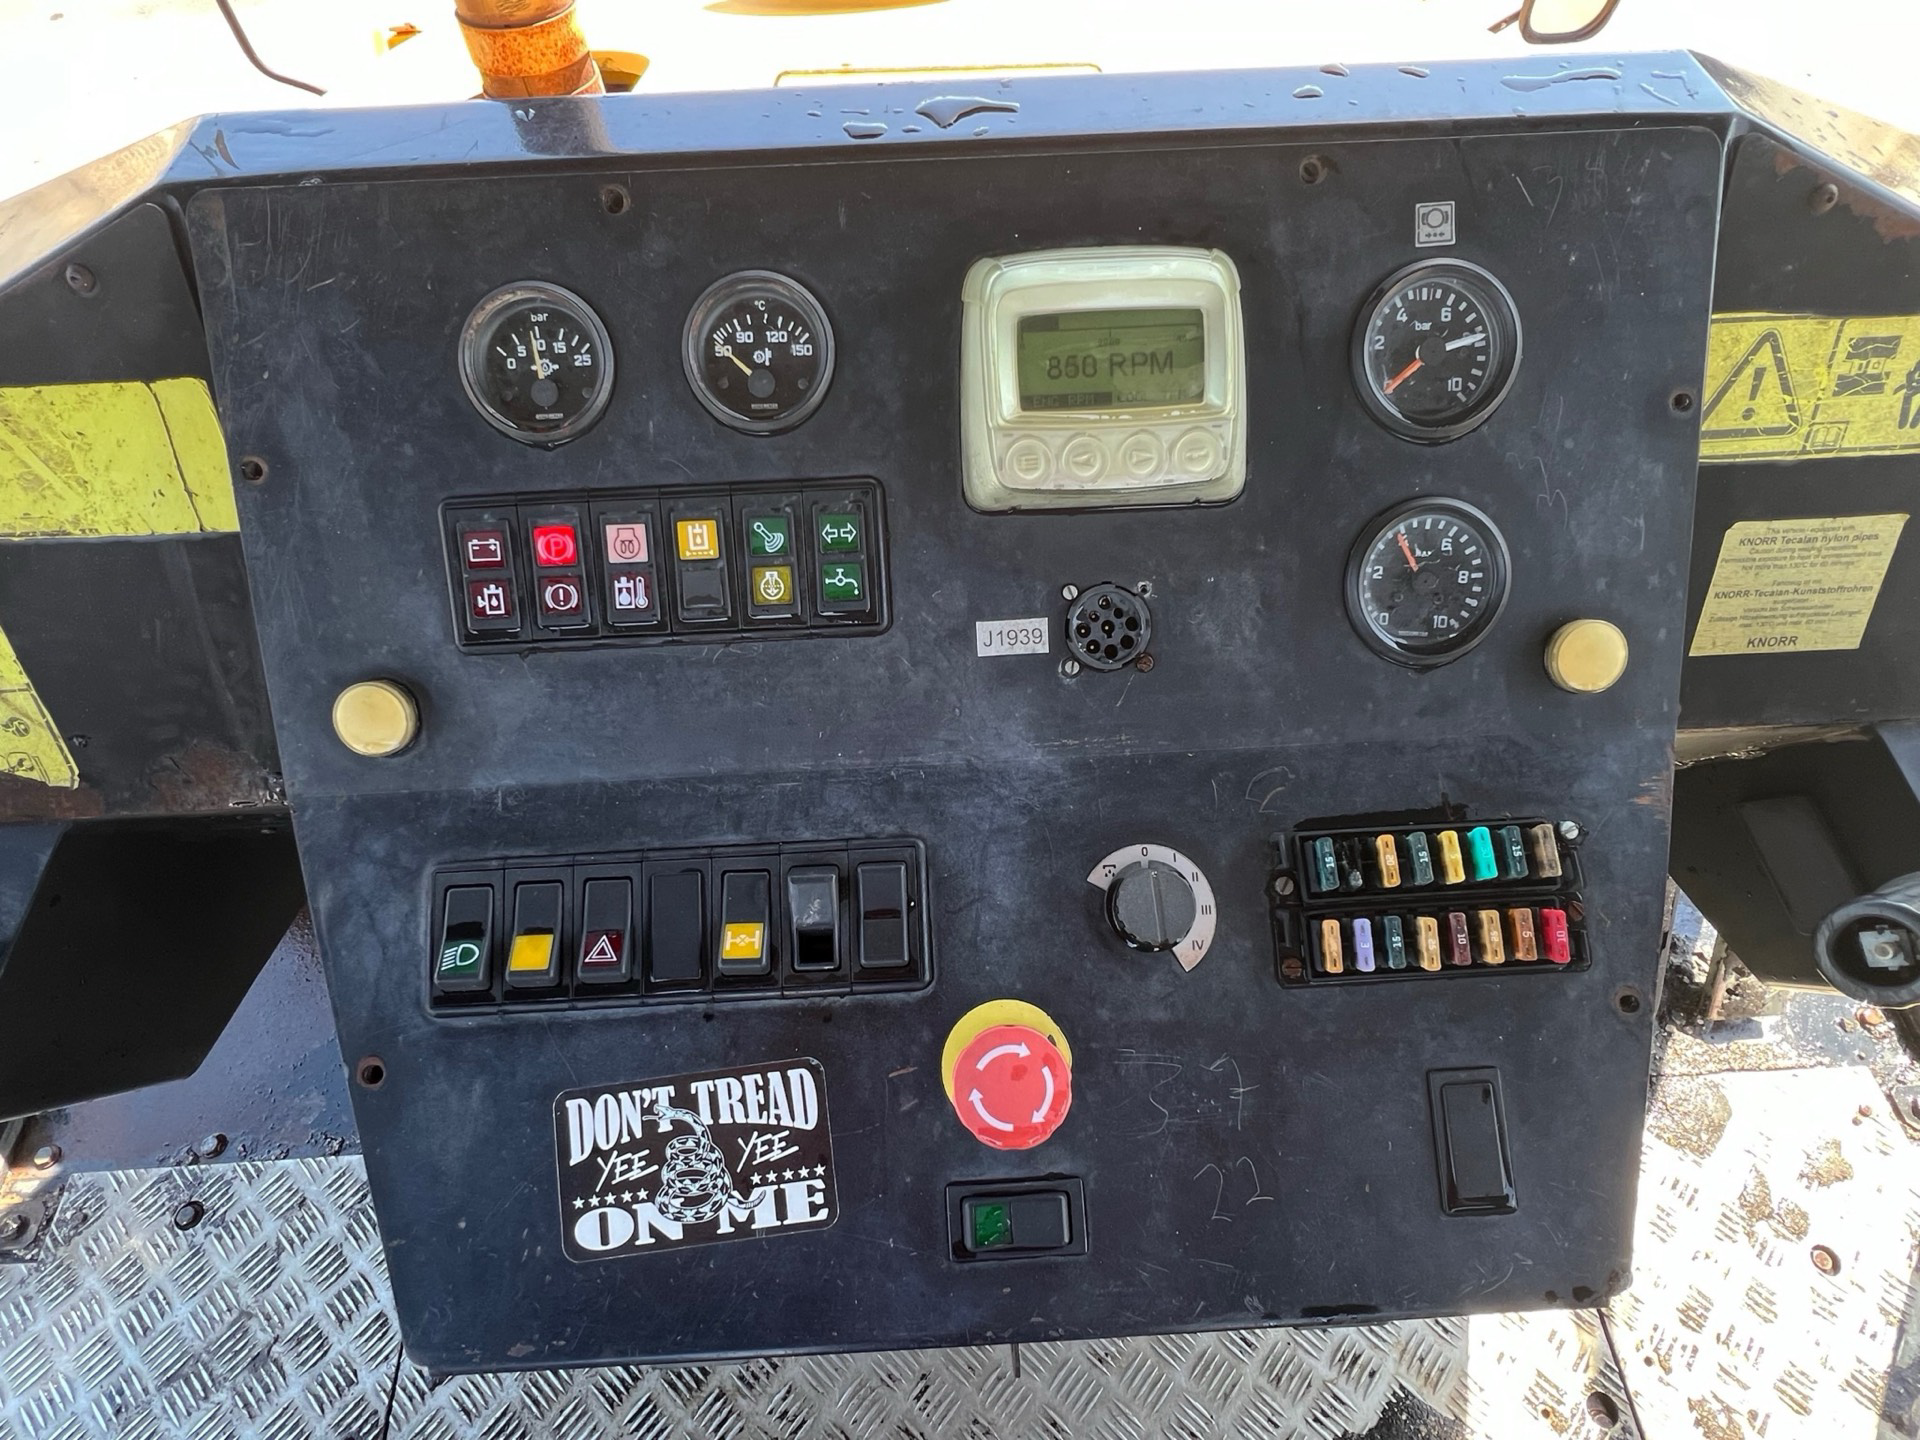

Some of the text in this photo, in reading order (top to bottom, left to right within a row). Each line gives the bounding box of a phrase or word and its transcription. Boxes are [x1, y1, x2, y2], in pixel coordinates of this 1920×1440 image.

[531, 312, 549, 322] bar
[1396, 308, 1408, 323] 4
[1440, 307, 1452, 322] 6
[1415, 321, 1432, 331] bar
[736, 331, 754, 343] 90
[766, 331, 788, 343] 120
[1374, 335, 1386, 350] 2
[517, 345, 527, 357] 5
[553, 341, 567, 354] 15
[715, 345, 733, 357] 50
[791, 344, 813, 356] 150
[507, 358, 517, 370] 0
[574, 354, 592, 367] 25
[1046, 350, 1174, 380] 850 RPM
[1447, 377, 1463, 392] 10
[1441, 537, 1452, 553] 6
[1738, 531, 1879, 547] KNORR Tecalan nylon pipes
[550, 537, 564, 557] P
[1372, 565, 1384, 580] 2
[1458, 570, 1469, 584] 8
[1713, 585, 1874, 600] KNORR-Tecalan-Kunststoffrohren
[1379, 612, 1389, 626] 0
[1433, 615, 1448, 629] 10
[983, 627, 1043, 648] J1939
[1746, 636, 1798, 649] KNORR
[1418, 851, 1429, 863] 15
[1511, 845, 1523, 857] 15
[1324, 856, 1335, 868] 15
[1386, 854, 1395, 866] 20
[1391, 935, 1402, 948] 15
[1456, 933, 1467, 945] 10
[1556, 930, 1567, 943] 10
[1192, 940, 1205, 951] IV
[565, 1068, 819, 1167] DON'T TREAD
[596, 1130, 800, 1193] YEE YEE
[574, 1178, 830, 1251] ON ME
